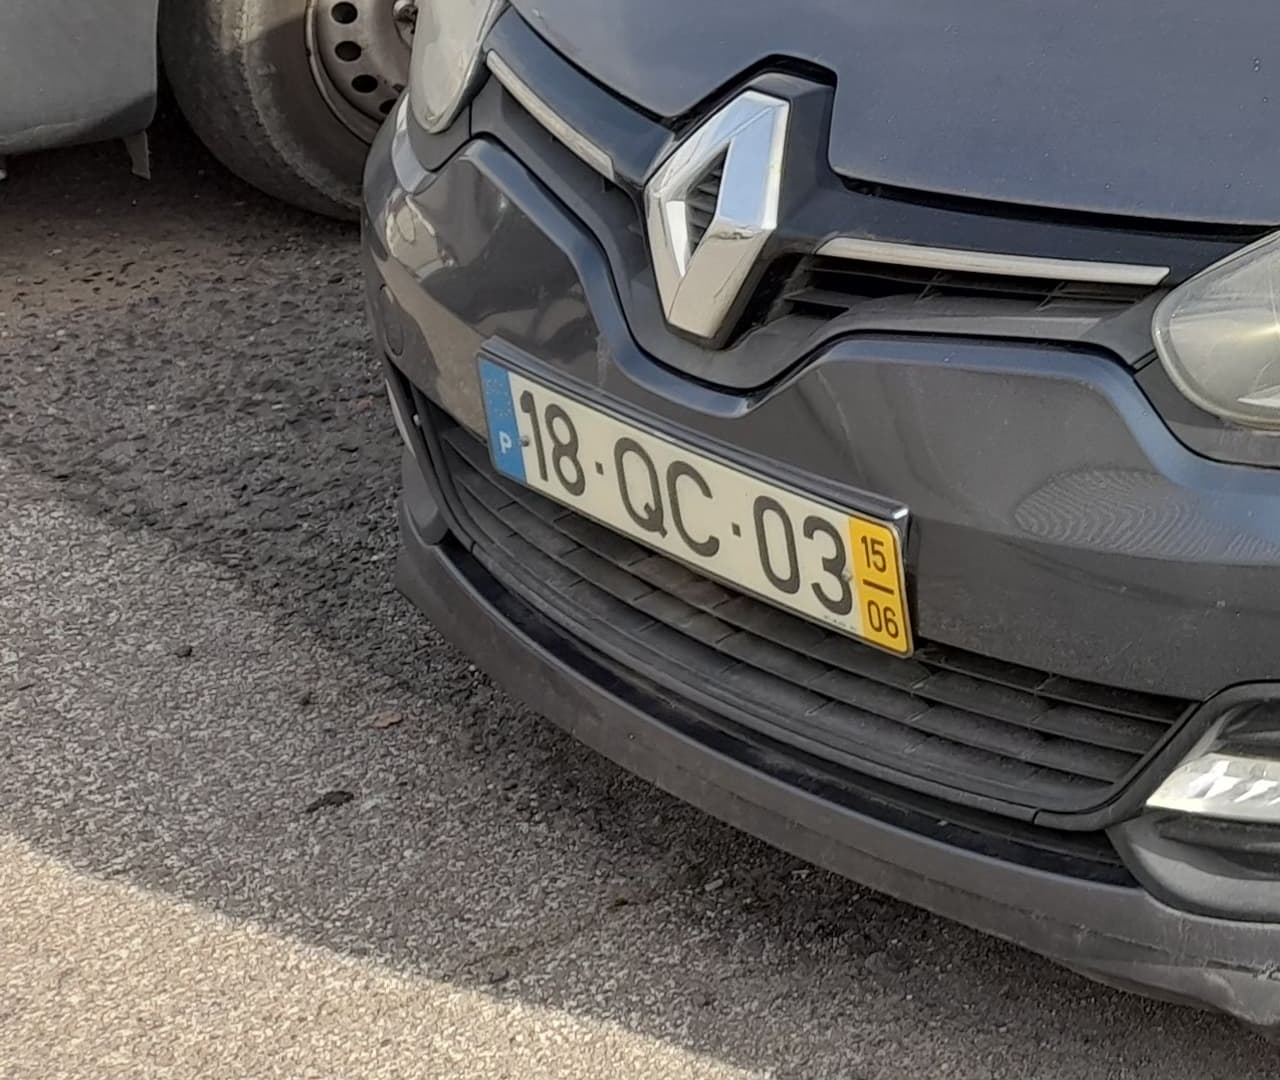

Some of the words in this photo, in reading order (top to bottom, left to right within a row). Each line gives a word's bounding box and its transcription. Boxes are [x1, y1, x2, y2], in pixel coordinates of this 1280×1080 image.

[498, 430, 513, 454] P
[860, 534, 887, 574] 15
[867, 601, 900, 641] 06
